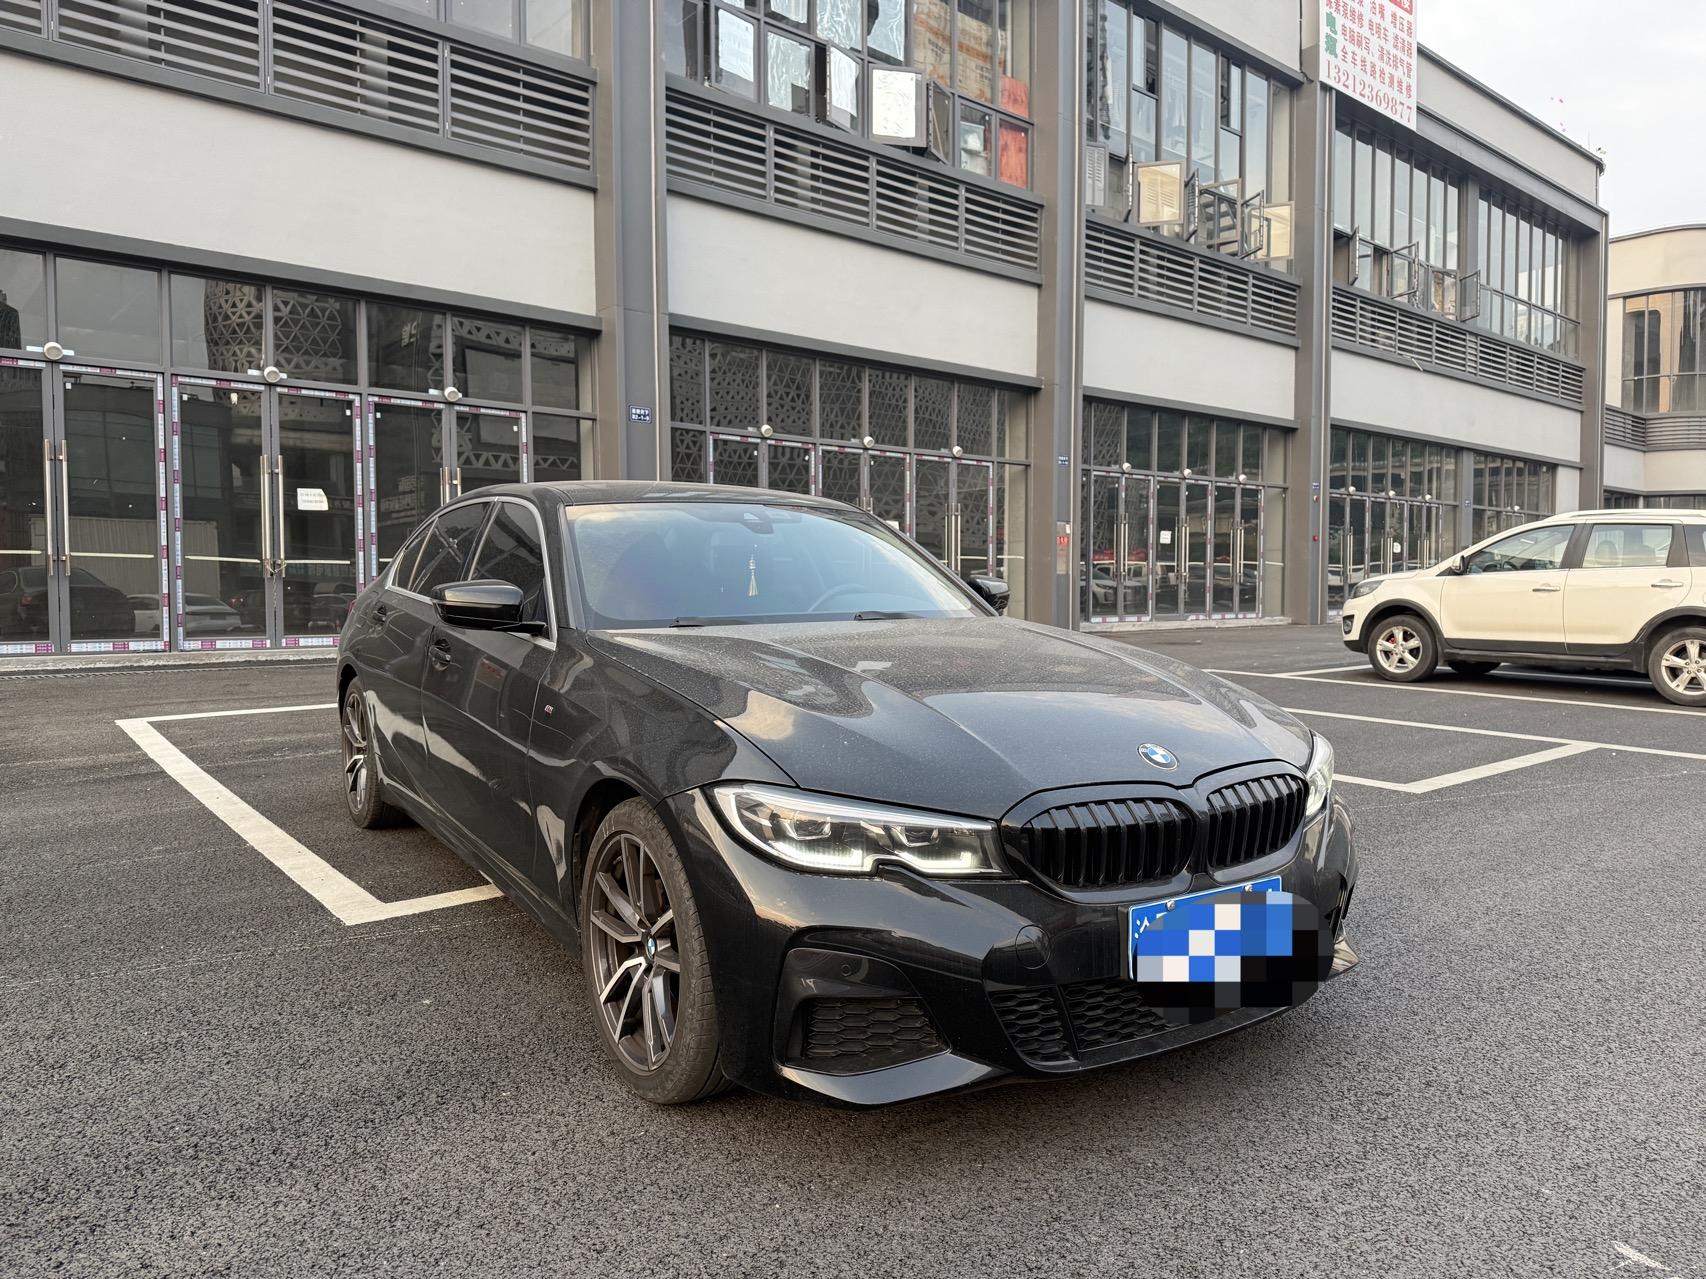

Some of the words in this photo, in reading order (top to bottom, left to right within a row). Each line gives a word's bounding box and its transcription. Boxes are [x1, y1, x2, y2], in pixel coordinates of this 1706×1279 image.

[1327, 60, 1412, 123] 13212369877
[1341, 45, 1412, 99] 全车线路检测维修
